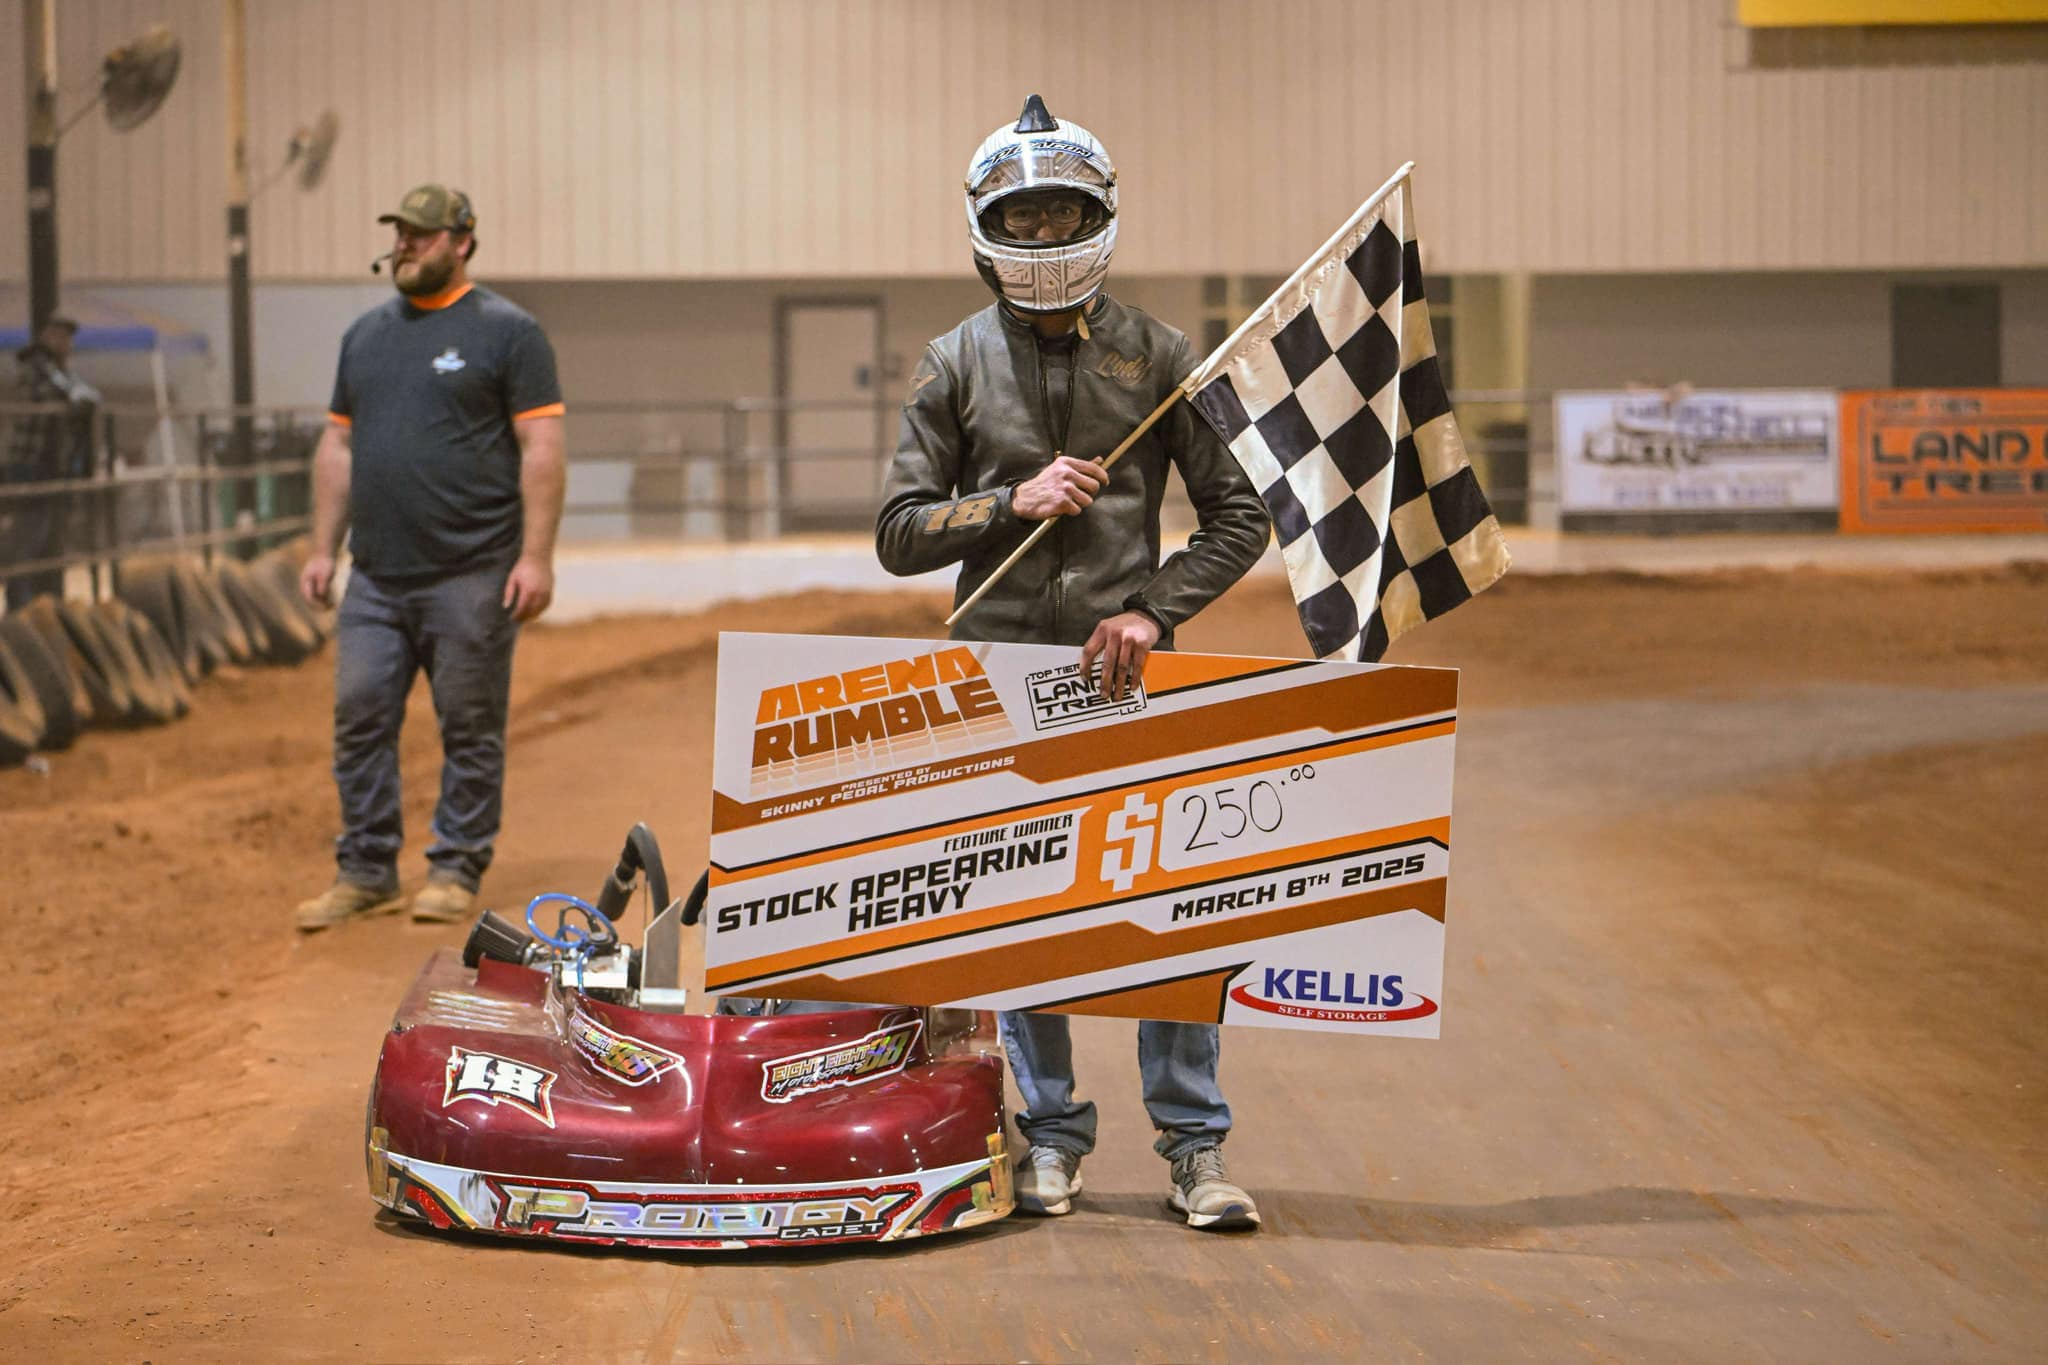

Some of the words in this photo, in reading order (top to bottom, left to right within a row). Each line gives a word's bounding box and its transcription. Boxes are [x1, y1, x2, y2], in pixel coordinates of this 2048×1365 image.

[1872, 430, 2031, 464] LAND
[755, 646, 986, 725] ARENA
[1029, 671, 1052, 681] TOP
[751, 678, 1005, 768] RUMBLE
[1120, 705, 1143, 716] LLC
[760, 796, 826, 818] SKINNY
[830, 784, 889, 803] PEDAL
[894, 755, 1016, 789] PRODUCTIONS
[841, 770, 913, 791] PRESENTED
[916, 766, 932, 777] BY
[943, 827, 1009, 853] FEATURE
[1013, 814, 1074, 838] WINNER
[717, 882, 838, 934] STOCK
[849, 834, 1069, 904] APPEARING
[1171, 884, 1277, 921] MARCH
[1341, 853, 1426, 887] 2025
[848, 882, 972, 933] HEAVY
[1263, 967, 1404, 1006] KELLIS
[1278, 1005, 1315, 1017] SELF
[1317, 1010, 1388, 1020] STORAGE
[457, 1055, 545, 1104] 18
[772, 1055, 825, 1082] EIGHT
[826, 1044, 872, 1069] EIGHT
[501, 1184, 911, 1236] PRODIGY
[780, 1222, 885, 1239] CADET
